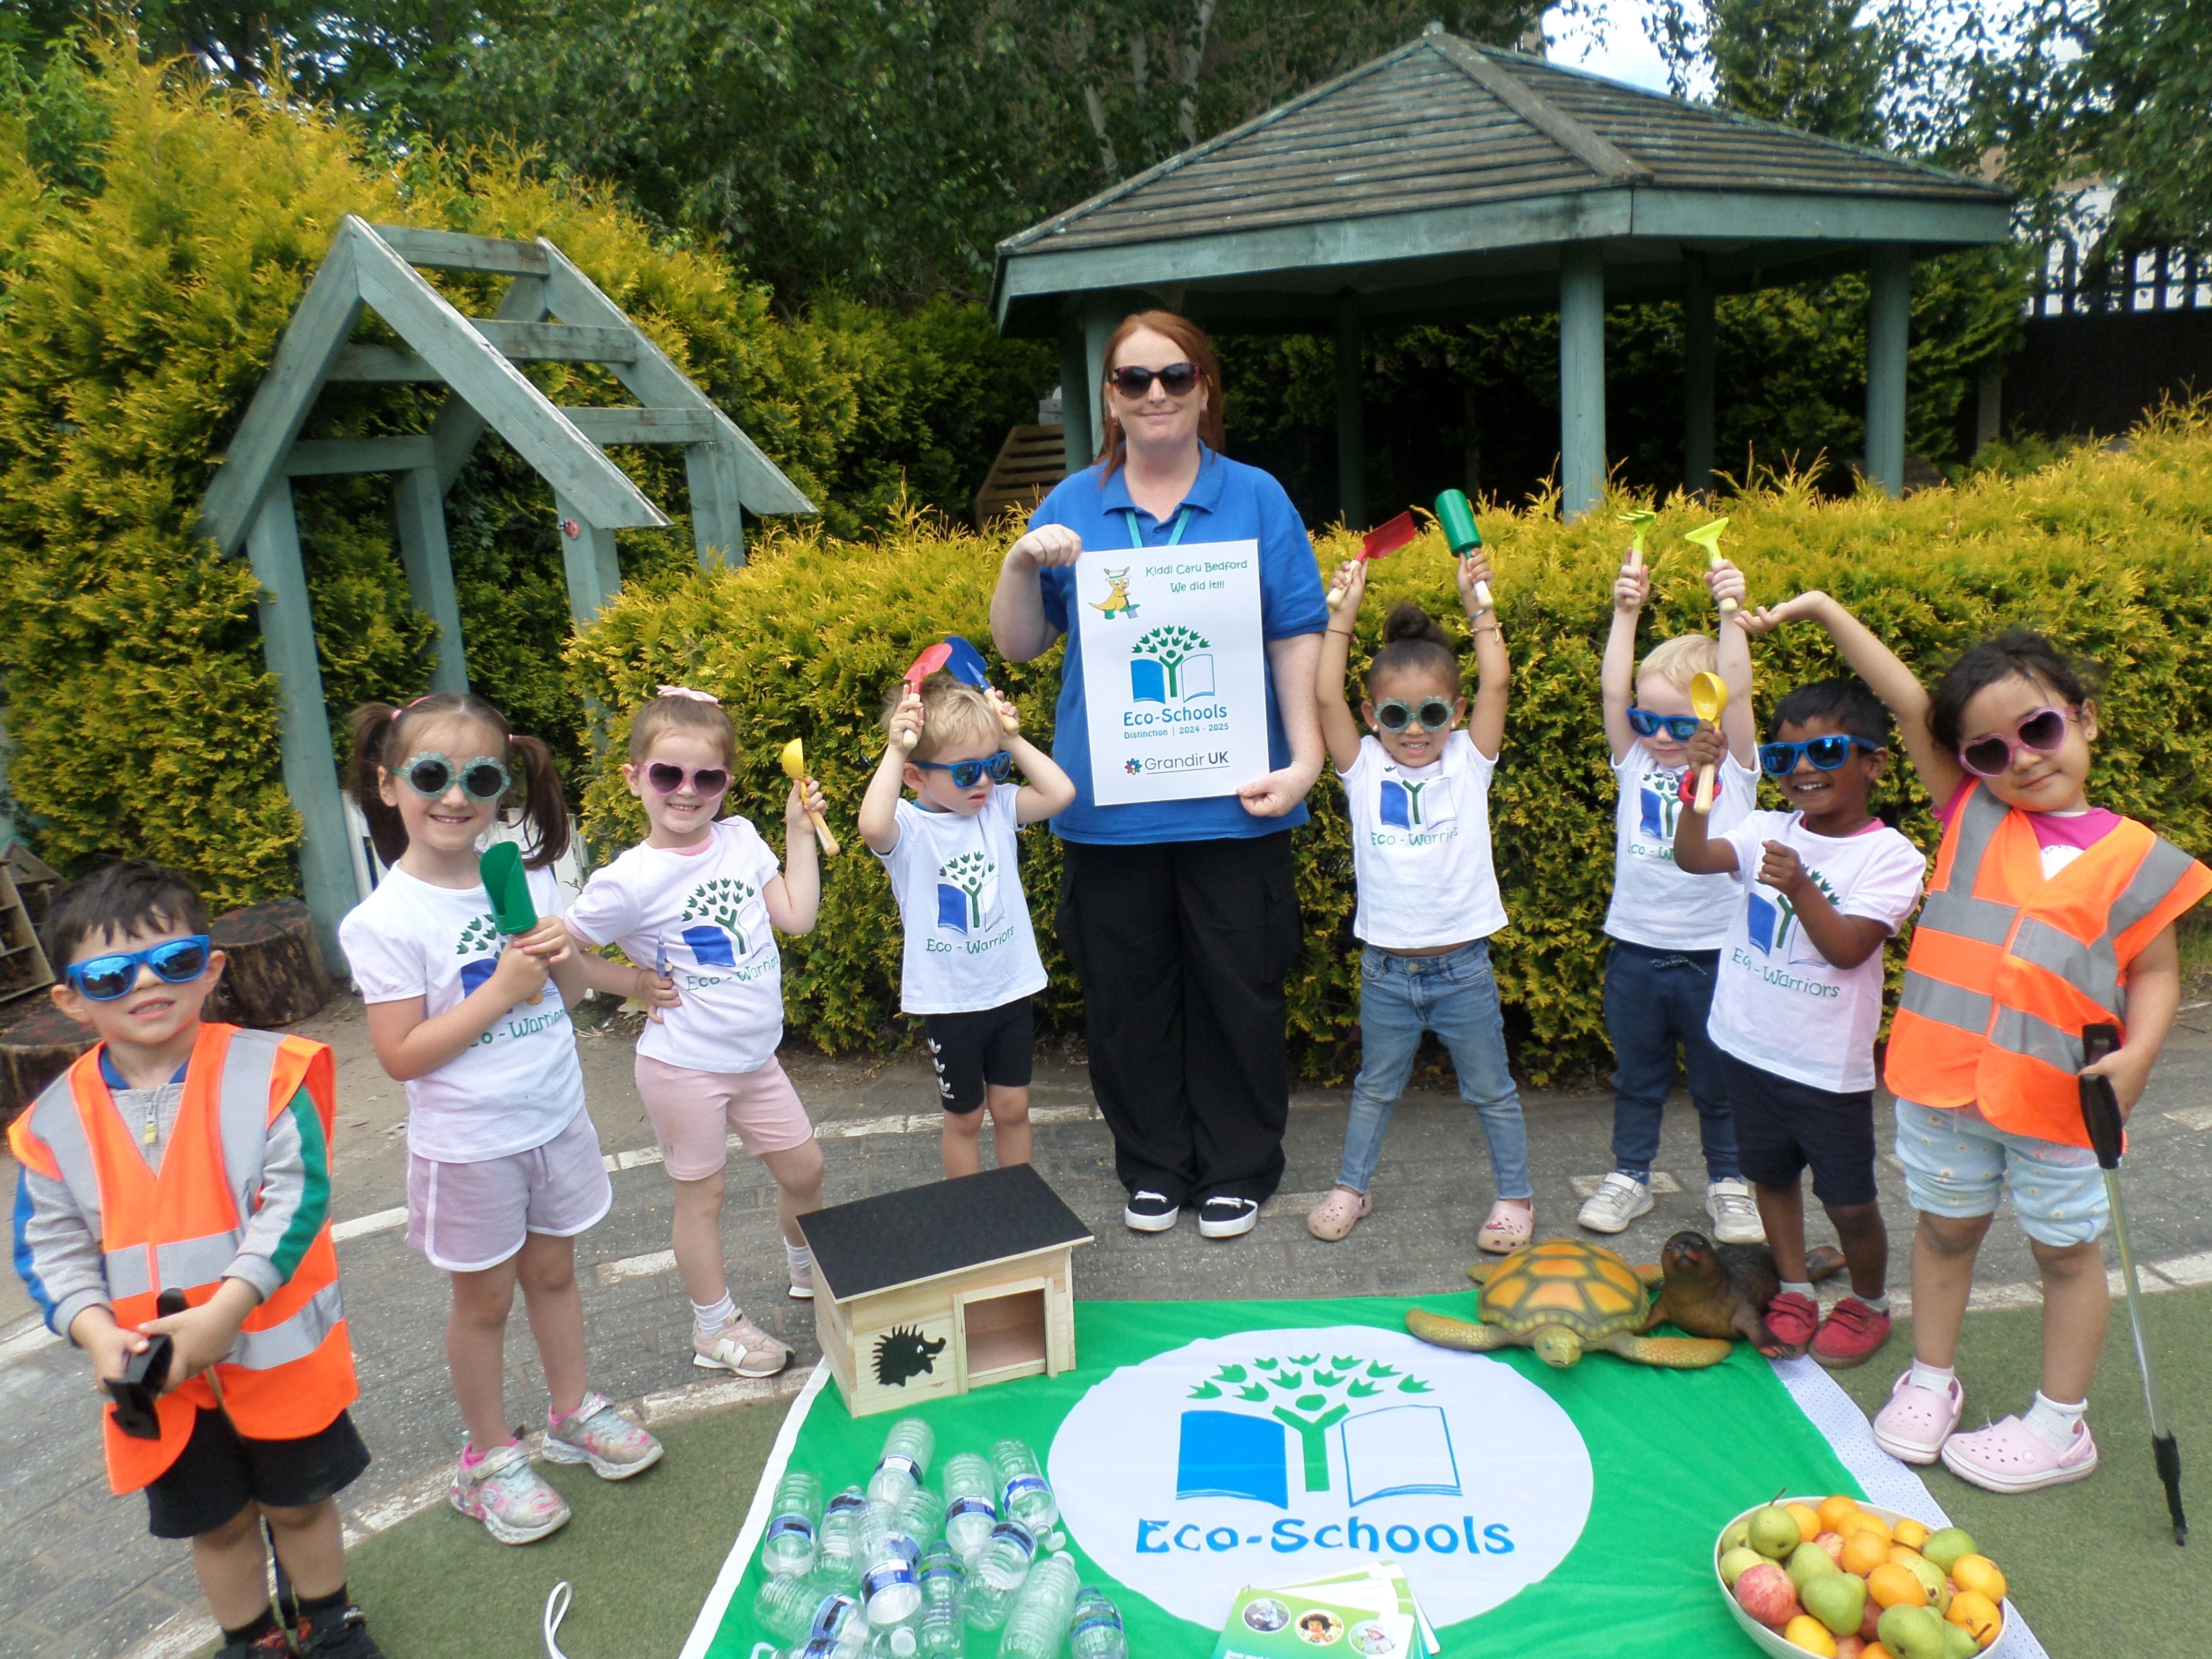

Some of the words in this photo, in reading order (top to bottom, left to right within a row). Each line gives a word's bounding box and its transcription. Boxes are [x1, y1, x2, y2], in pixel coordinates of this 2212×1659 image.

[1146, 565, 1173, 577] Kiddi
[1176, 564, 1202, 575] Caru
[1204, 560, 1247, 572] Bedford
[1170, 582, 1187, 593] We
[1190, 581, 1205, 590] did
[1209, 580, 1225, 589] it!!!
[1124, 704, 1227, 726] Eco-Schools
[1124, 729, 1168, 739] Distinction
[1179, 725, 1200, 734] 2024
[1208, 723, 1229, 731] 2025
[1145, 753, 1204, 770] Grandir
[1208, 751, 1229, 764] UK
[926, 938, 952, 952] Eco
[965, 926, 1014, 954] Warriors
[686, 976, 720, 991] Eco
[1763, 965, 1840, 997] Warriors
[1136, 1515, 1515, 1554] Eco-Schools
